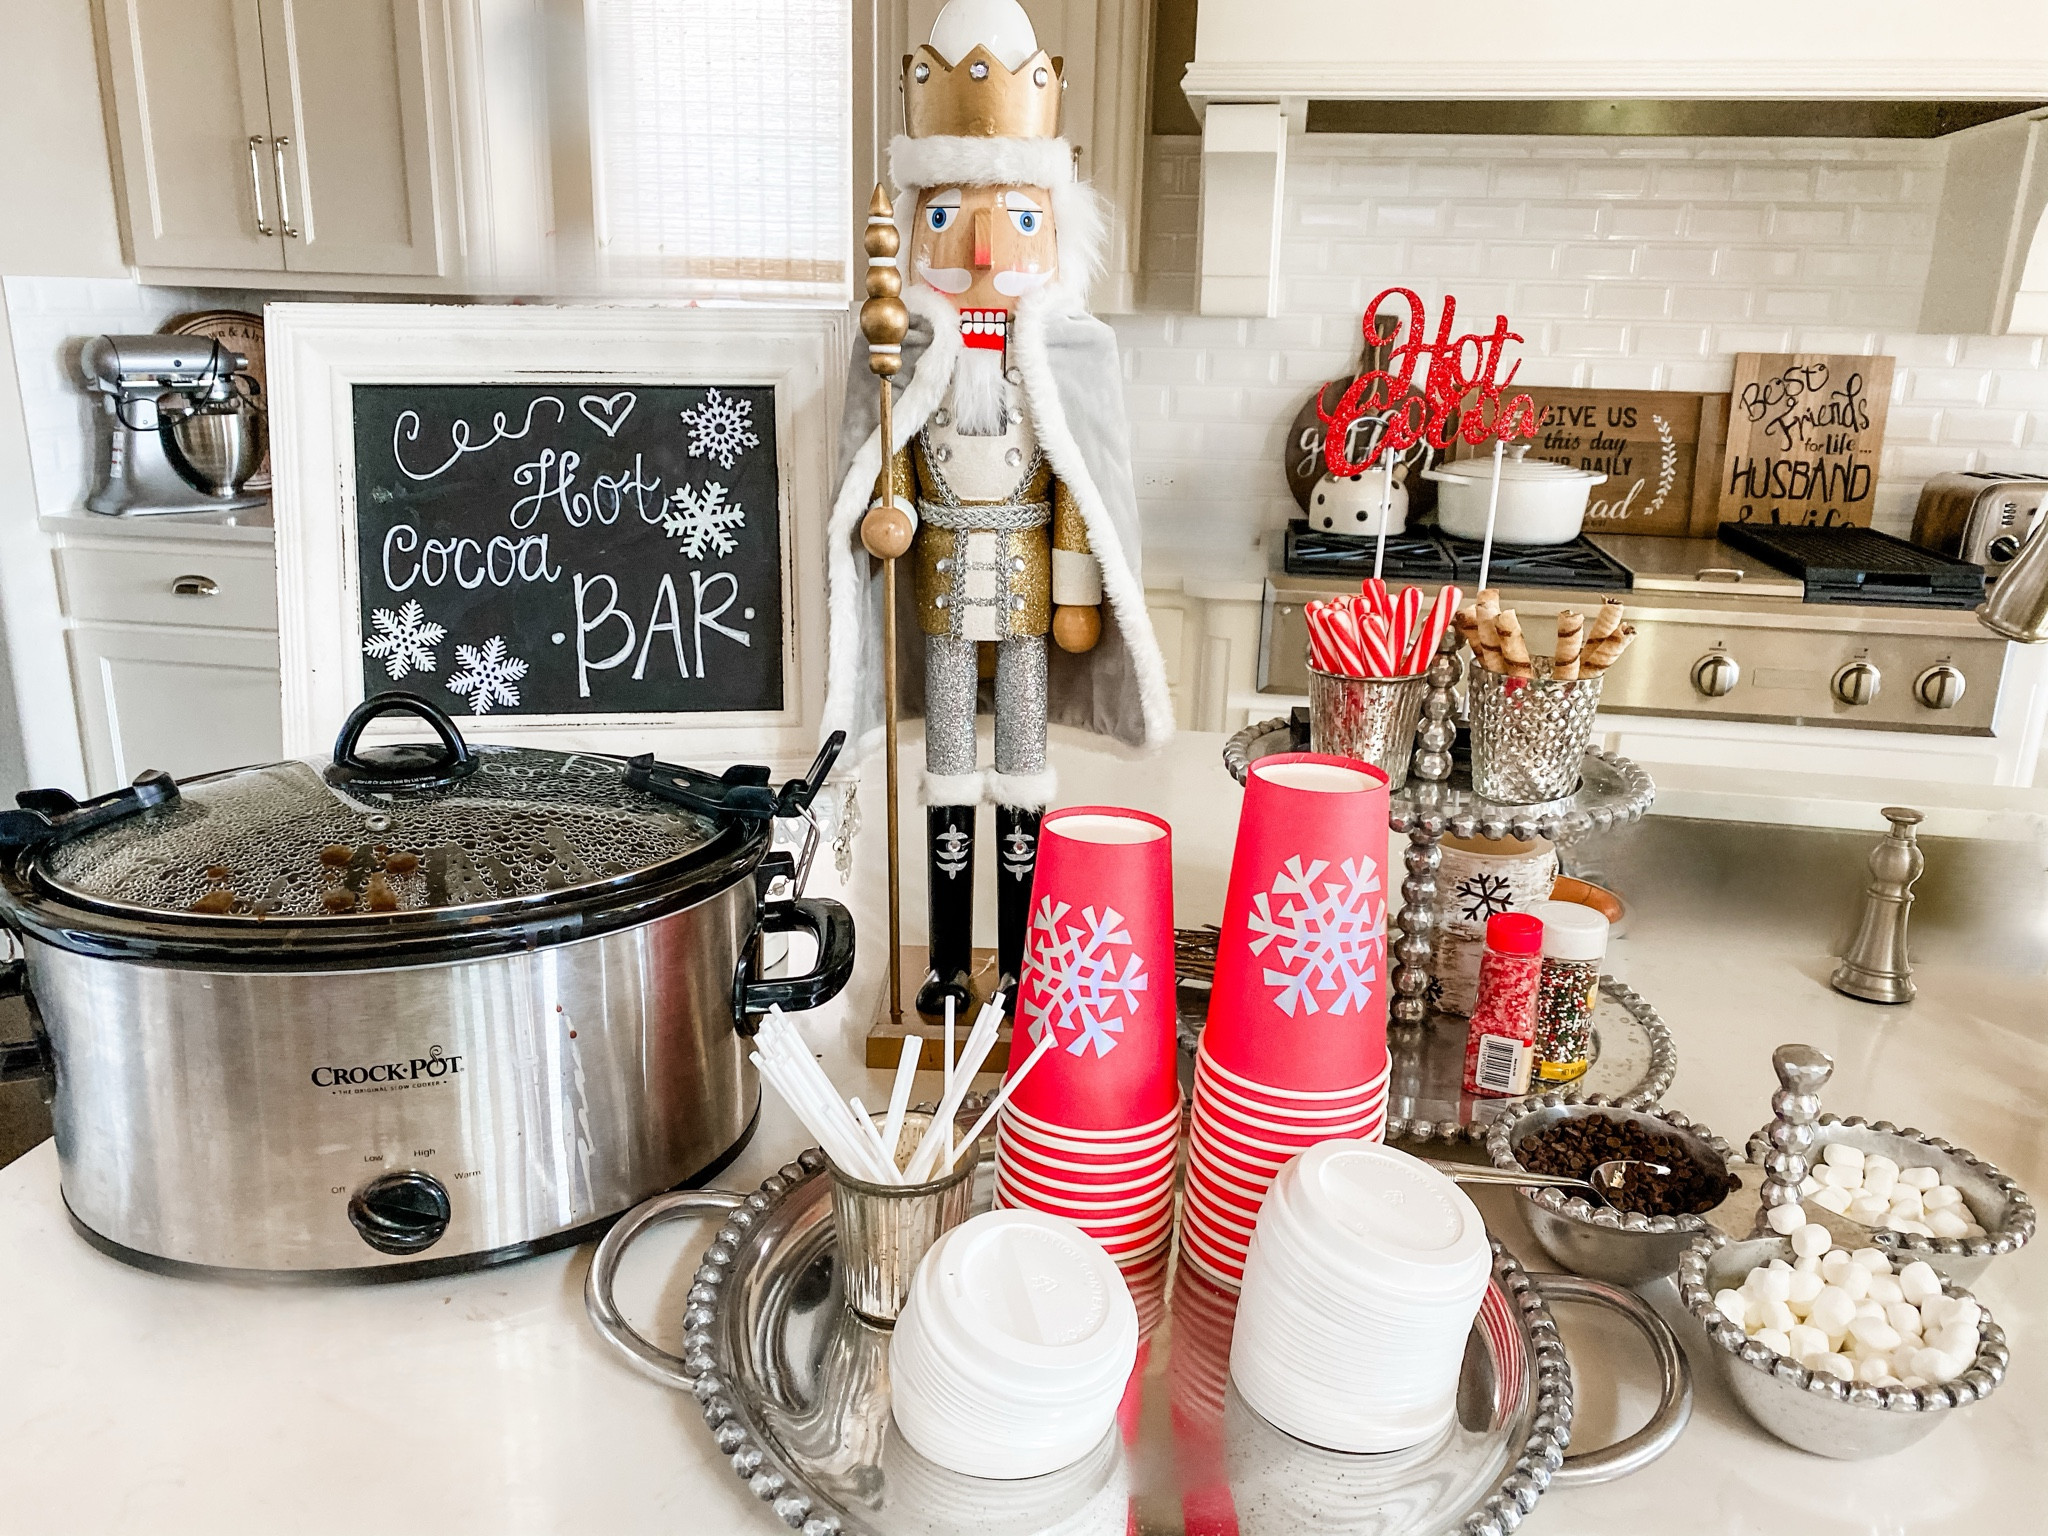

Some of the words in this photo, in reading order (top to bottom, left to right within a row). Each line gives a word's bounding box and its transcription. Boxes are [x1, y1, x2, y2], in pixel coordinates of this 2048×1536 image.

[1363, 287, 1525, 407] Hot
[1739, 363, 1830, 423] Best
[1317, 370, 1549, 478] Cocoa
[1539, 405, 1597, 428] GIVE
[1607, 406, 1638, 428] US
[1765, 373, 1870, 452] Friends
[1543, 429, 1580, 450] this
[1589, 430, 1628, 456] day
[1804, 437, 1824, 453] for
[1581, 456, 1633, 476] DAILY
[1729, 454, 1871, 503] HUSBAND
[510, 448, 670, 529] Hot
[383, 524, 562, 592] Cocoa
[364, 1154, 384, 1163] Low
[413, 1148, 436, 1158] High
[454, 1169, 481, 1180] Warm
[331, 1186, 346, 1195] Off
